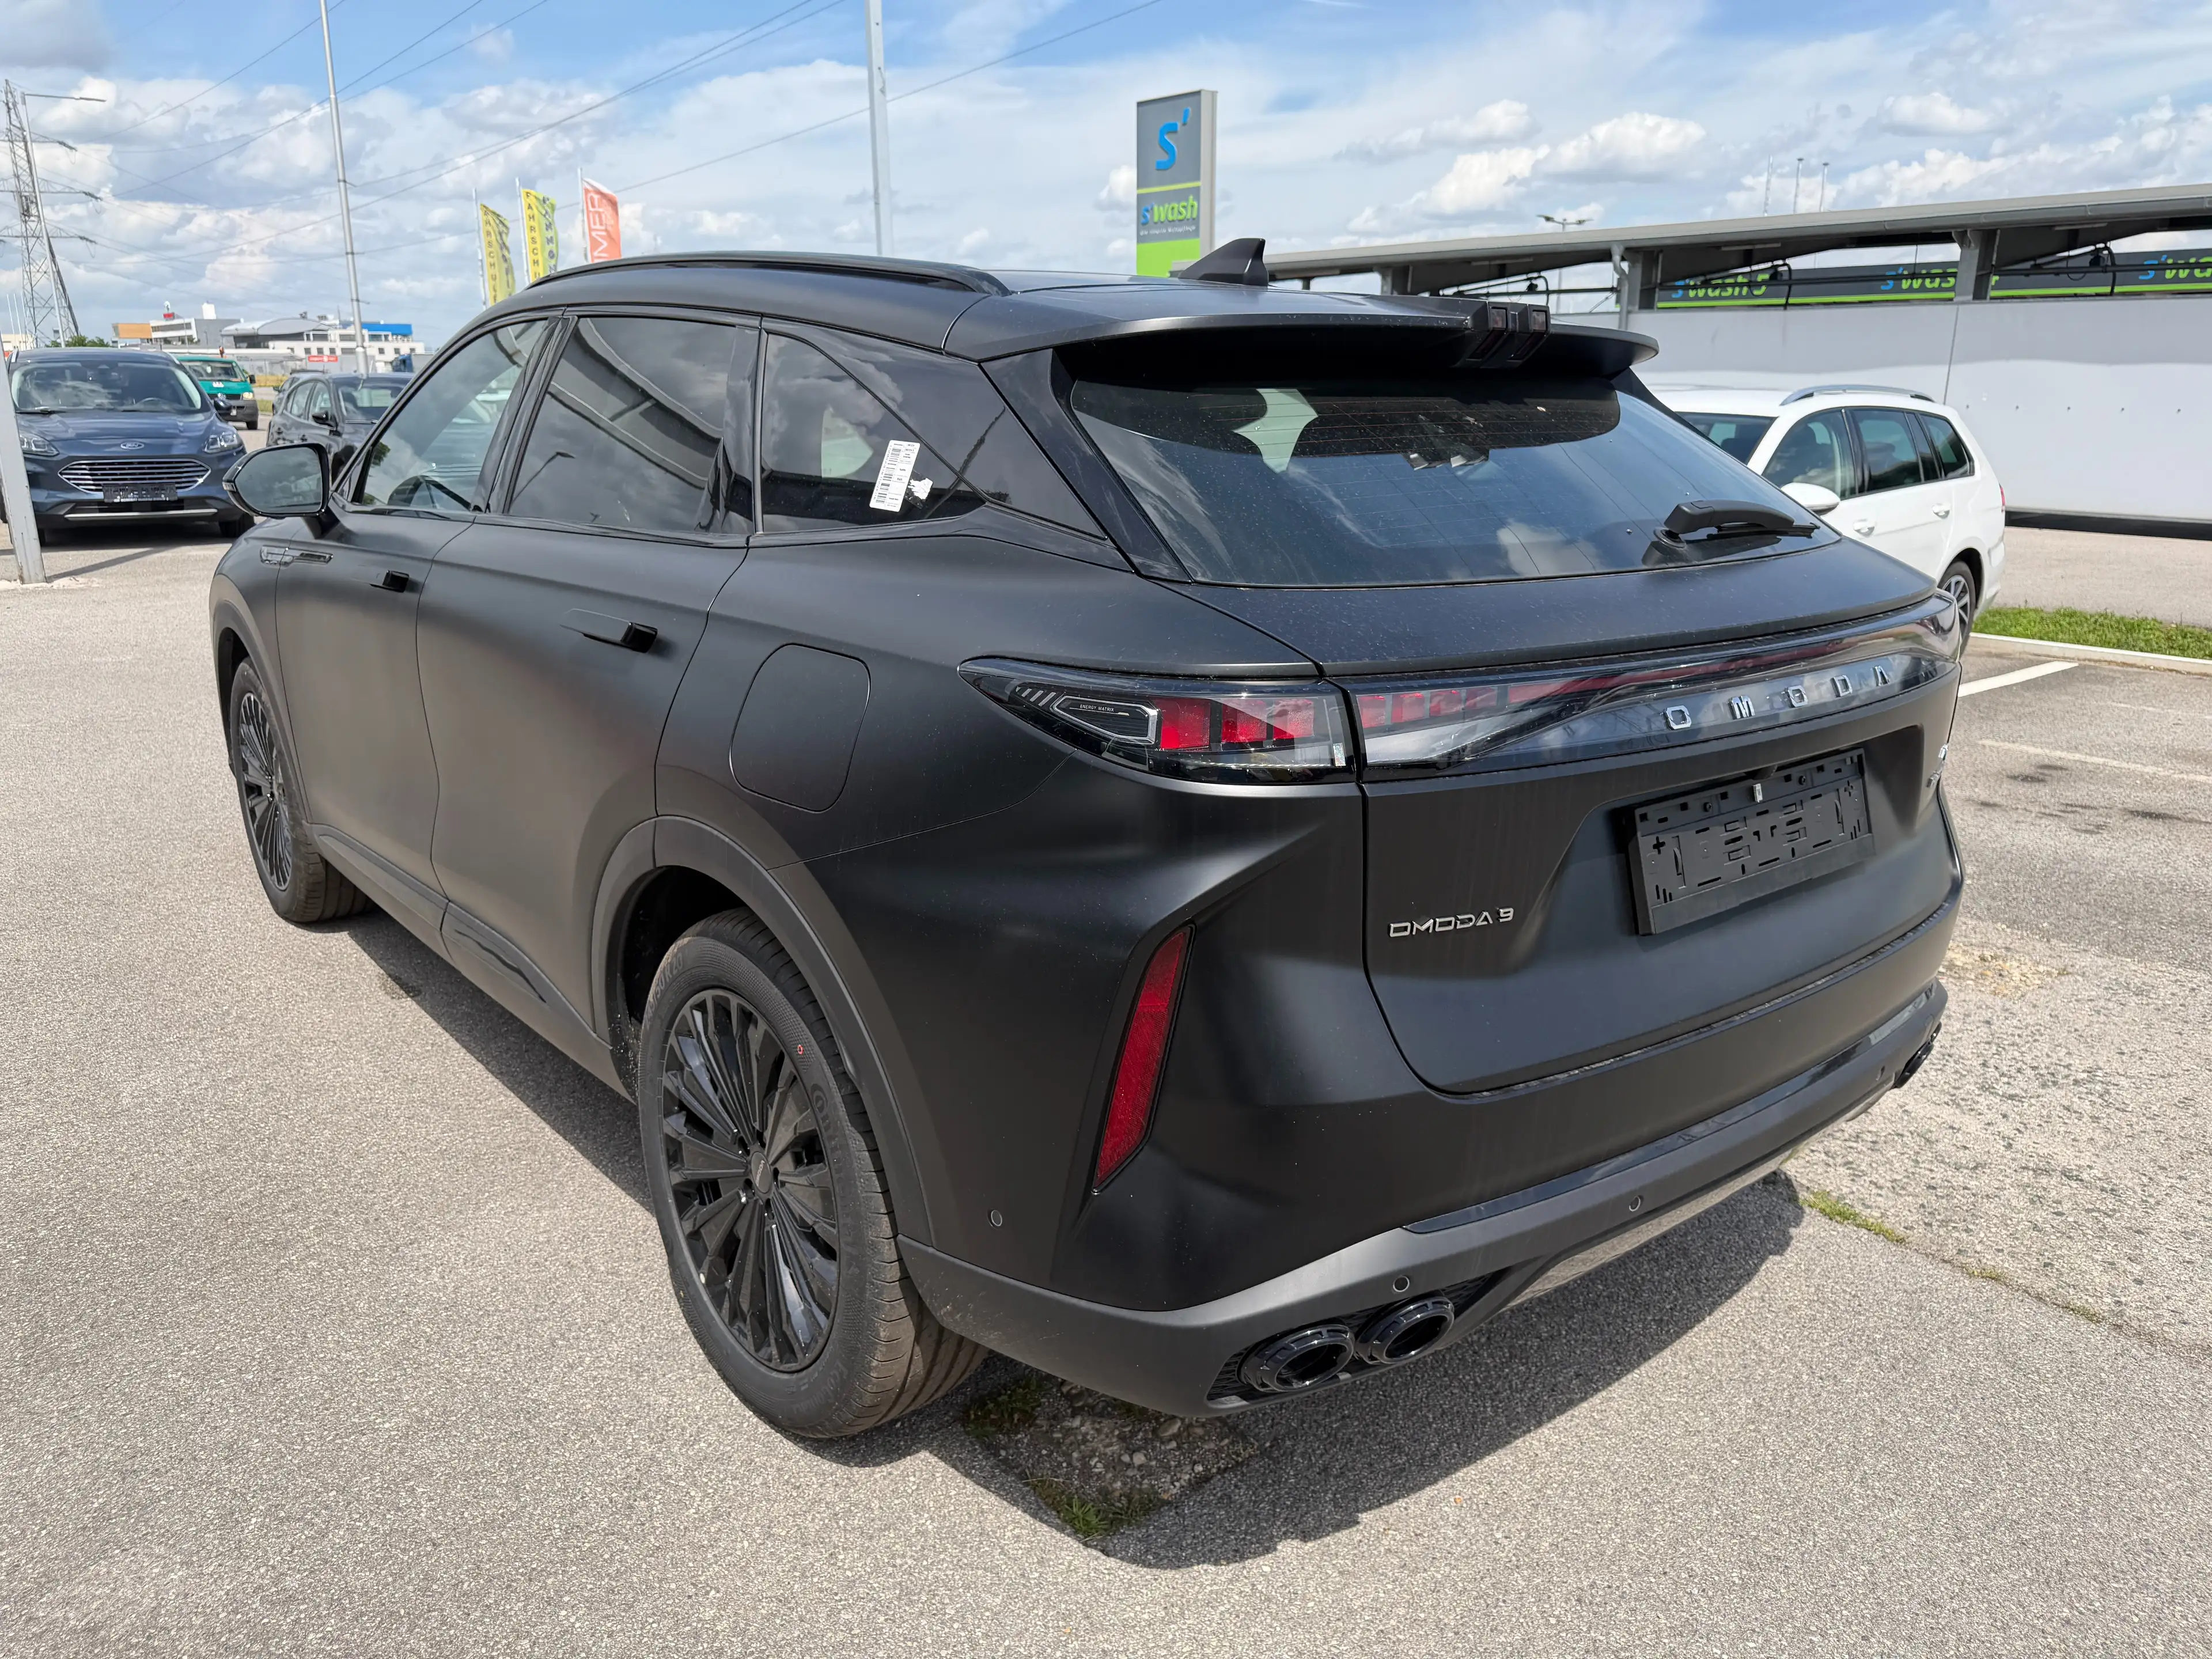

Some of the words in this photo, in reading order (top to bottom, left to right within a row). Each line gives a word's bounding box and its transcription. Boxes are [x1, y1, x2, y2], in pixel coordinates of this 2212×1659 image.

[1141, 195, 1198, 225] s'wash
[1880, 267, 1958, 290] s'was
[1389, 911, 1493, 937] OMODA
[1498, 907, 1514, 922] 9
